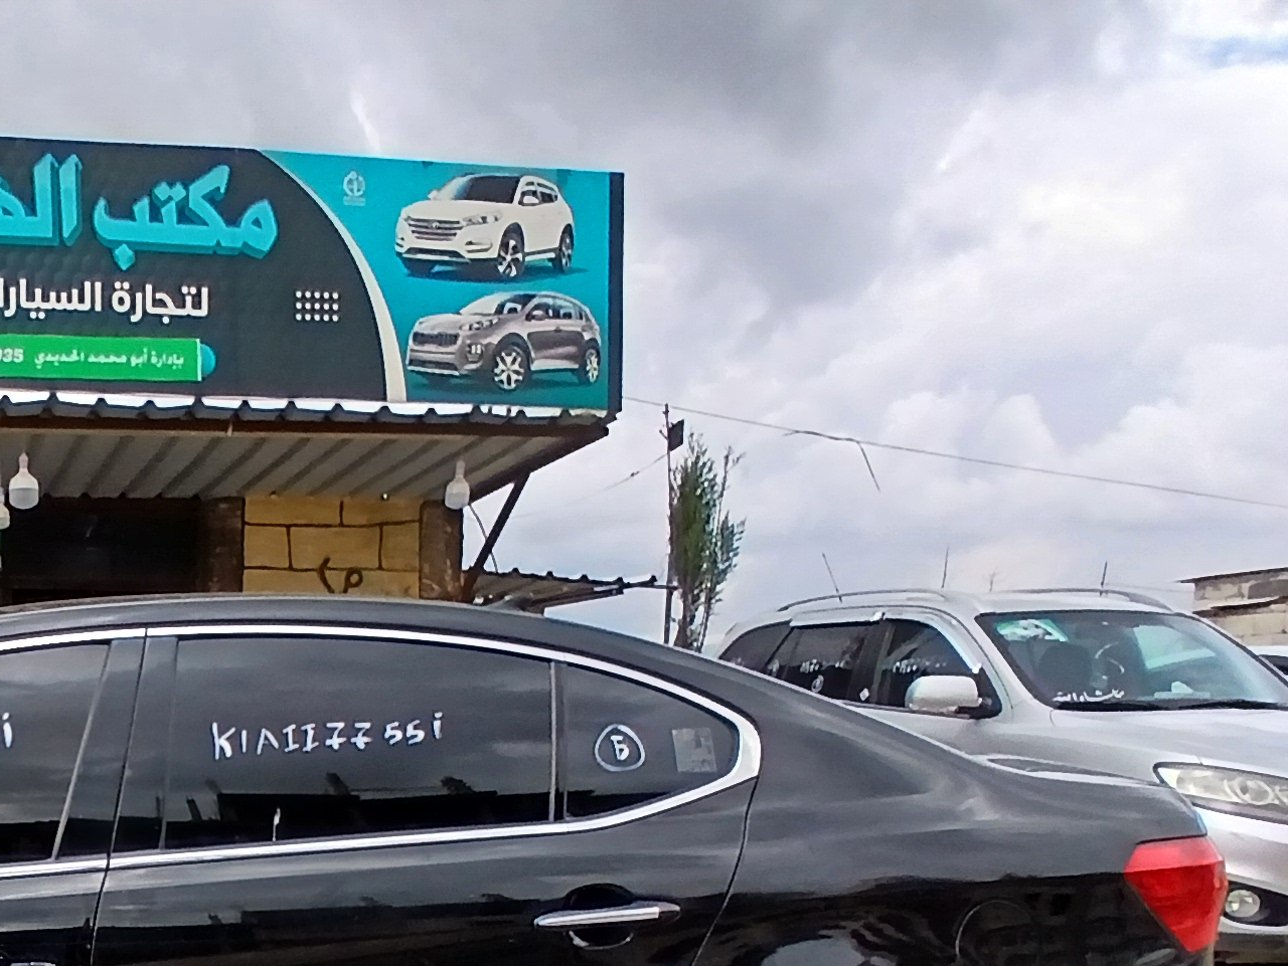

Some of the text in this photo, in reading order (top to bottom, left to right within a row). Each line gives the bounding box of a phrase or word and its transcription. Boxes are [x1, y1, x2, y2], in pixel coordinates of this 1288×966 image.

[93, 164, 279, 270] مكتب
[111, 281, 209, 324] لتجارة
[87, 352, 128, 365] محمد
[130, 347, 148, 369] أبو
[150, 350, 185, 370] بإدارة
